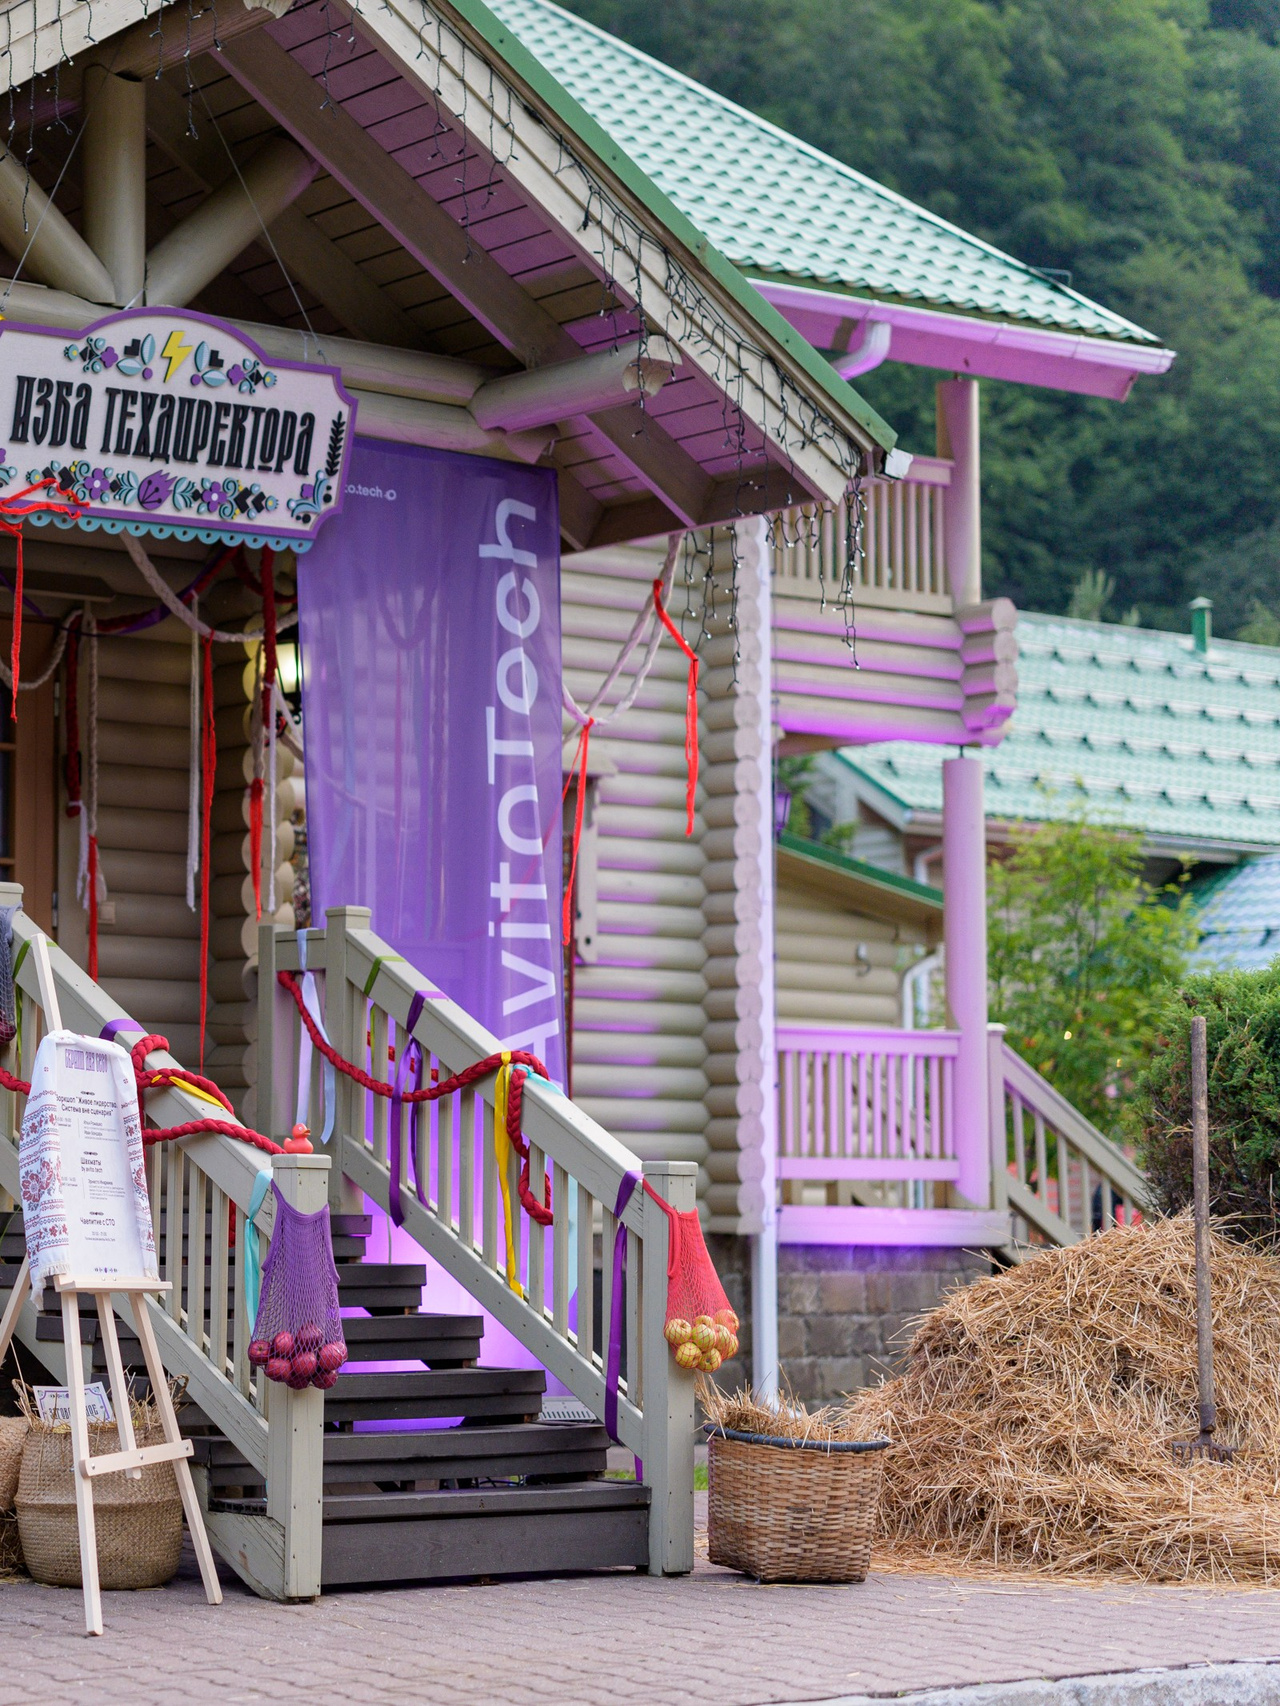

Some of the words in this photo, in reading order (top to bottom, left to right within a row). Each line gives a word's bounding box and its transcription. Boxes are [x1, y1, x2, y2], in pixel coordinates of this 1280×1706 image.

[9, 374, 92, 450] ИЗБА
[99, 386, 316, 477] ТЕХДИРЕКТОРА
[477, 497, 563, 1090] AvitoTech
